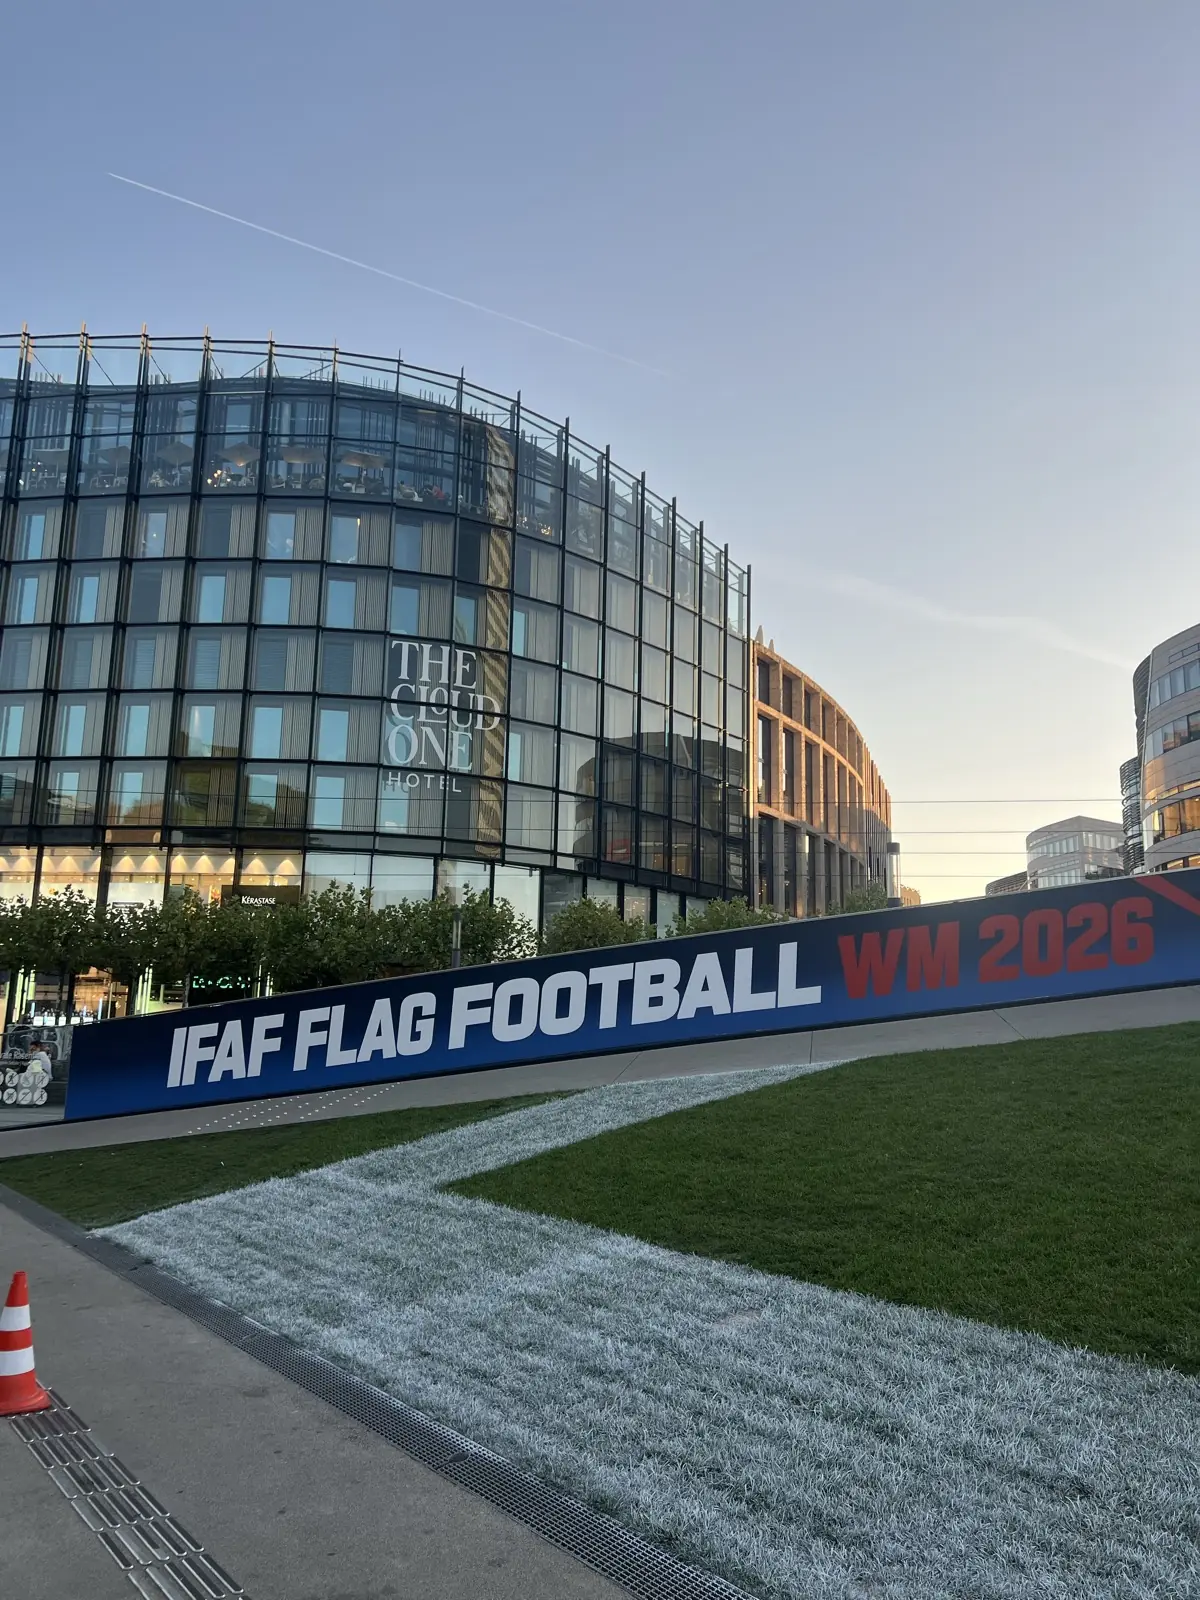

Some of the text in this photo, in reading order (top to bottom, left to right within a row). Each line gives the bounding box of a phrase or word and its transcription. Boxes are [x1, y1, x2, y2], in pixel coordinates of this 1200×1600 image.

[392, 641, 476, 689] THE
[391, 684, 500, 731] CLOUD
[388, 725, 472, 771] ONE
[388, 772, 461, 793] HOTEL
[241, 895, 276, 905] KÉRASTASE
[167, 897, 1154, 1087] IFAF FLAG FOOTBALL WM 2026
